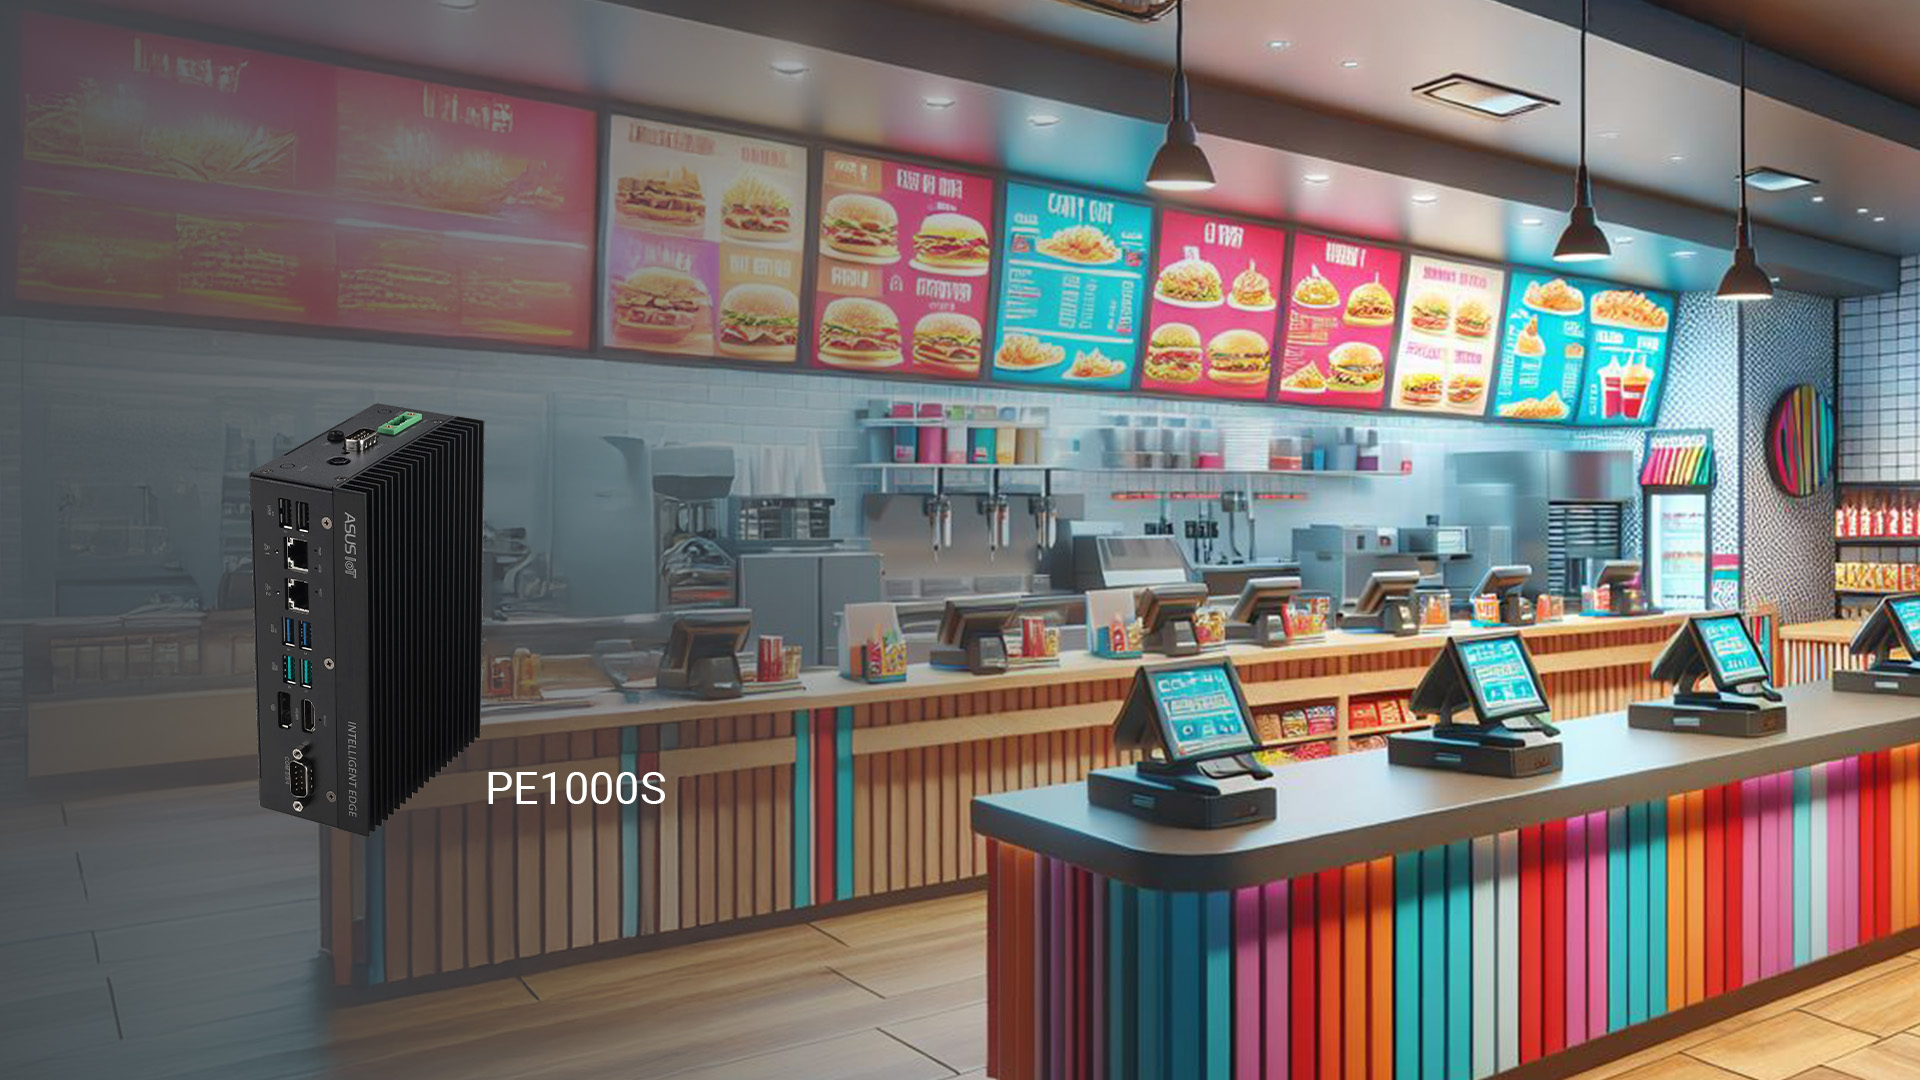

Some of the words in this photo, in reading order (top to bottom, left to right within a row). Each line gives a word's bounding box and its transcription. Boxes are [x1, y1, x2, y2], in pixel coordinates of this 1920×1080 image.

[344, 511, 356, 555] ASUS
[344, 556, 357, 579] IoT
[347, 720, 357, 788] INTELLIGENT
[348, 789, 357, 818] EDGE
